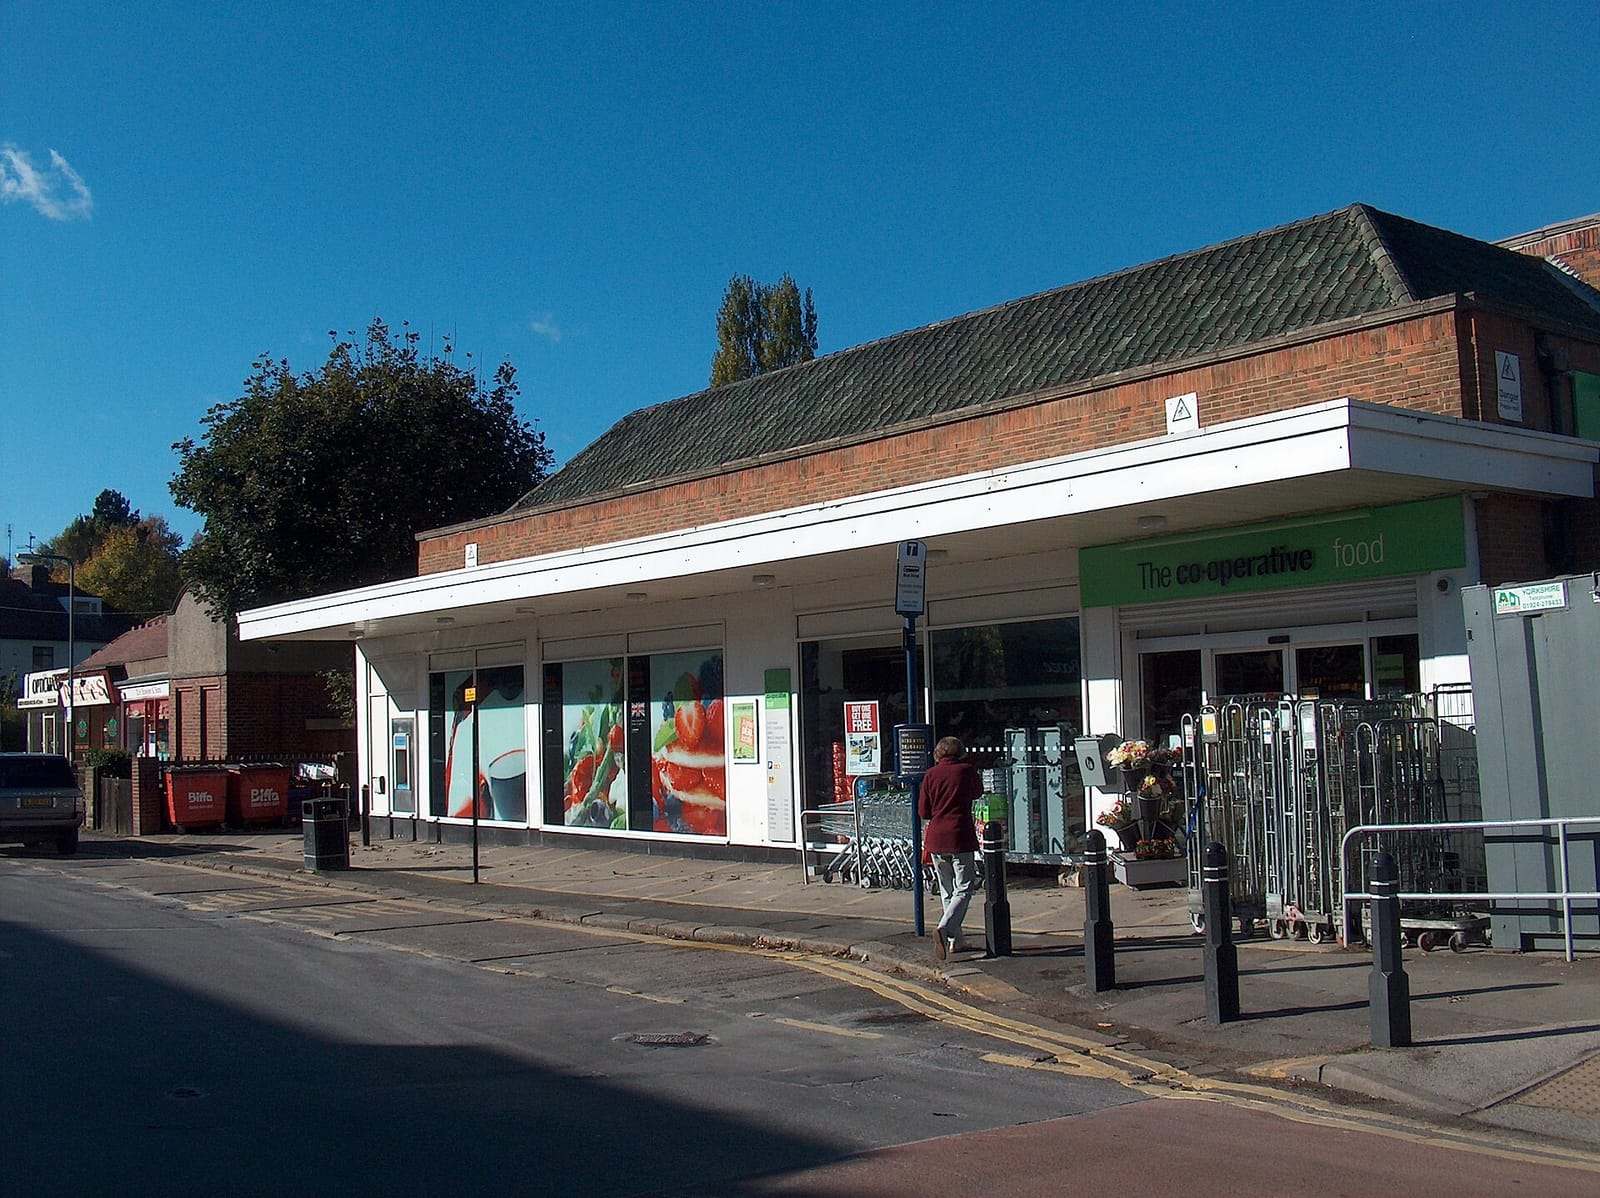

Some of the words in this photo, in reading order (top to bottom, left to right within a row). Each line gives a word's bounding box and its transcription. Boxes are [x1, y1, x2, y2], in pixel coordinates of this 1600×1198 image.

[1137, 562, 1171, 590] The
[1176, 546, 1314, 587] co-operative
[1332, 533, 1384, 567] food
[1522, 584, 1561, 596] YORKSHIRE
[852, 719, 873, 732] FREE
[188, 792, 213, 803] Biffa
[250, 788, 280, 802] Biffa
